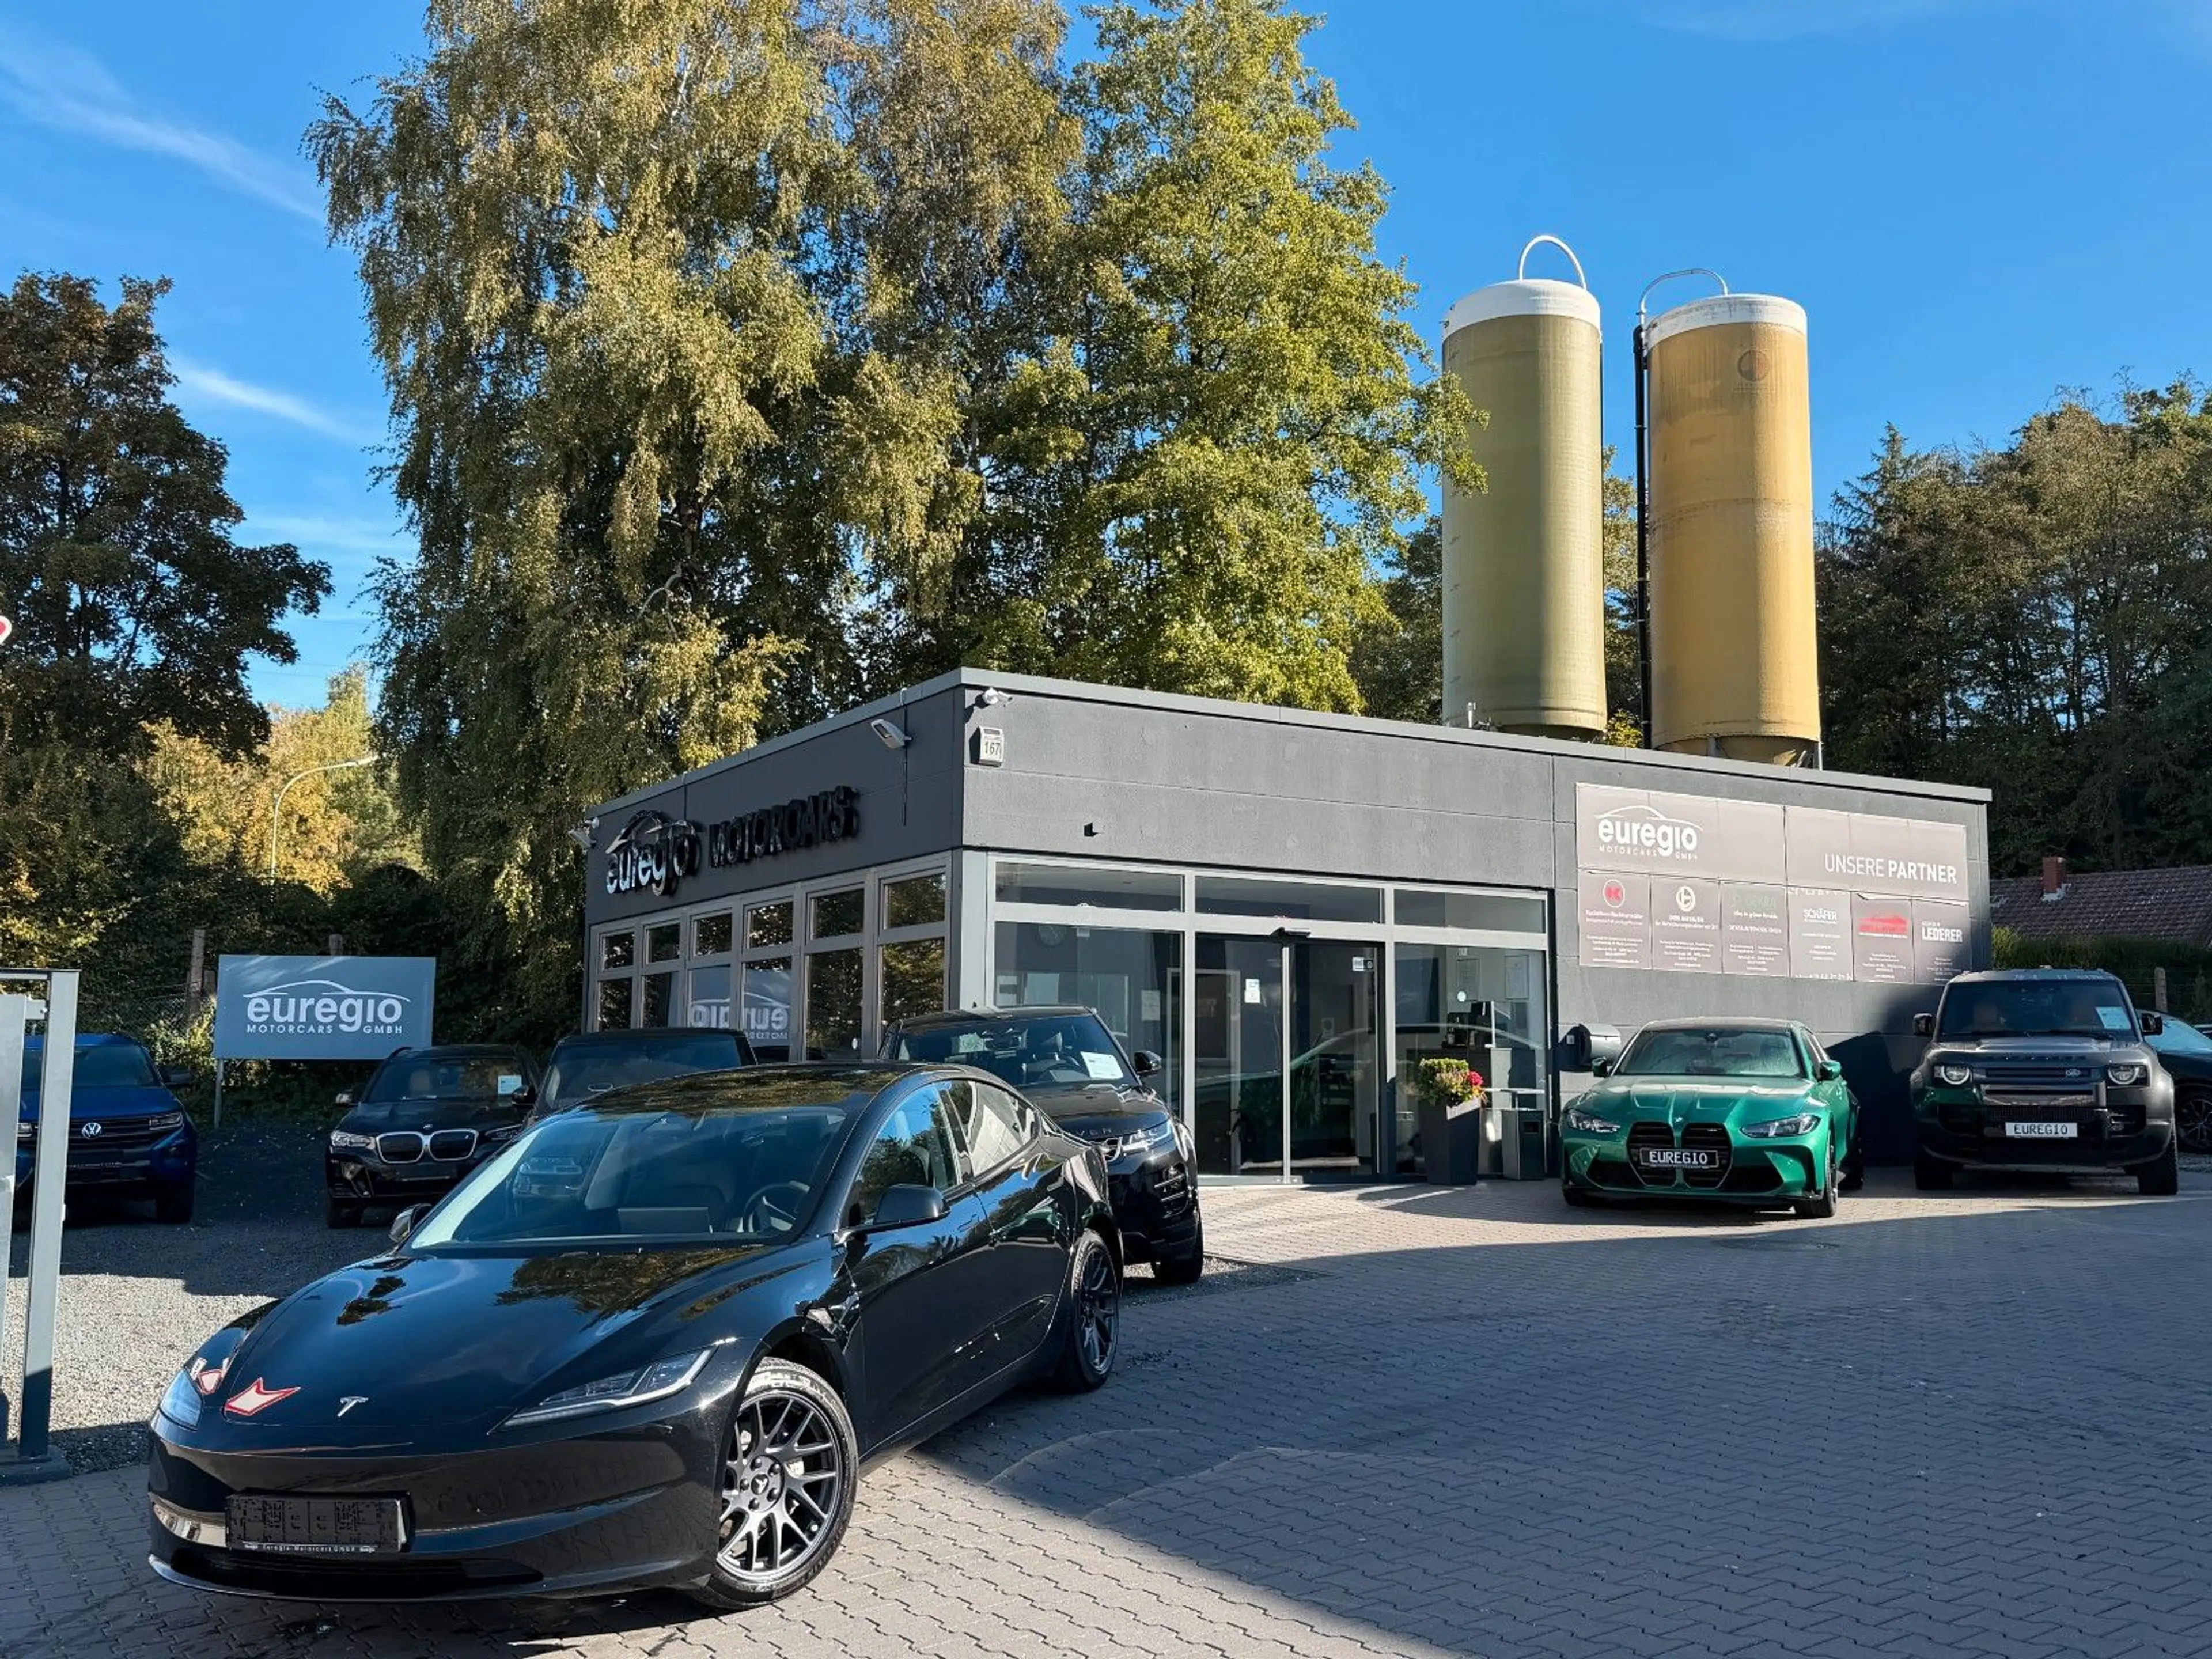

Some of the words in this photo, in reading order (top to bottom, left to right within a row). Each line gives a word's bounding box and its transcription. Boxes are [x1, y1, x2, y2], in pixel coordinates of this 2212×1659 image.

[984, 741, 1001, 755] 167
[1597, 819, 1698, 857] euregio
[1824, 853, 1885, 877] UNSERE
[1888, 860, 1957, 884] PARTNER
[1921, 926, 1963, 942] LEDERER
[247, 997, 402, 1032] euregio
[246, 1024, 333, 1033] MOTORCARS
[363, 1025, 403, 1034] GMBH
[2013, 1124, 2069, 1135] EUREGIO
[1649, 1151, 1707, 1165] EUREGIO
